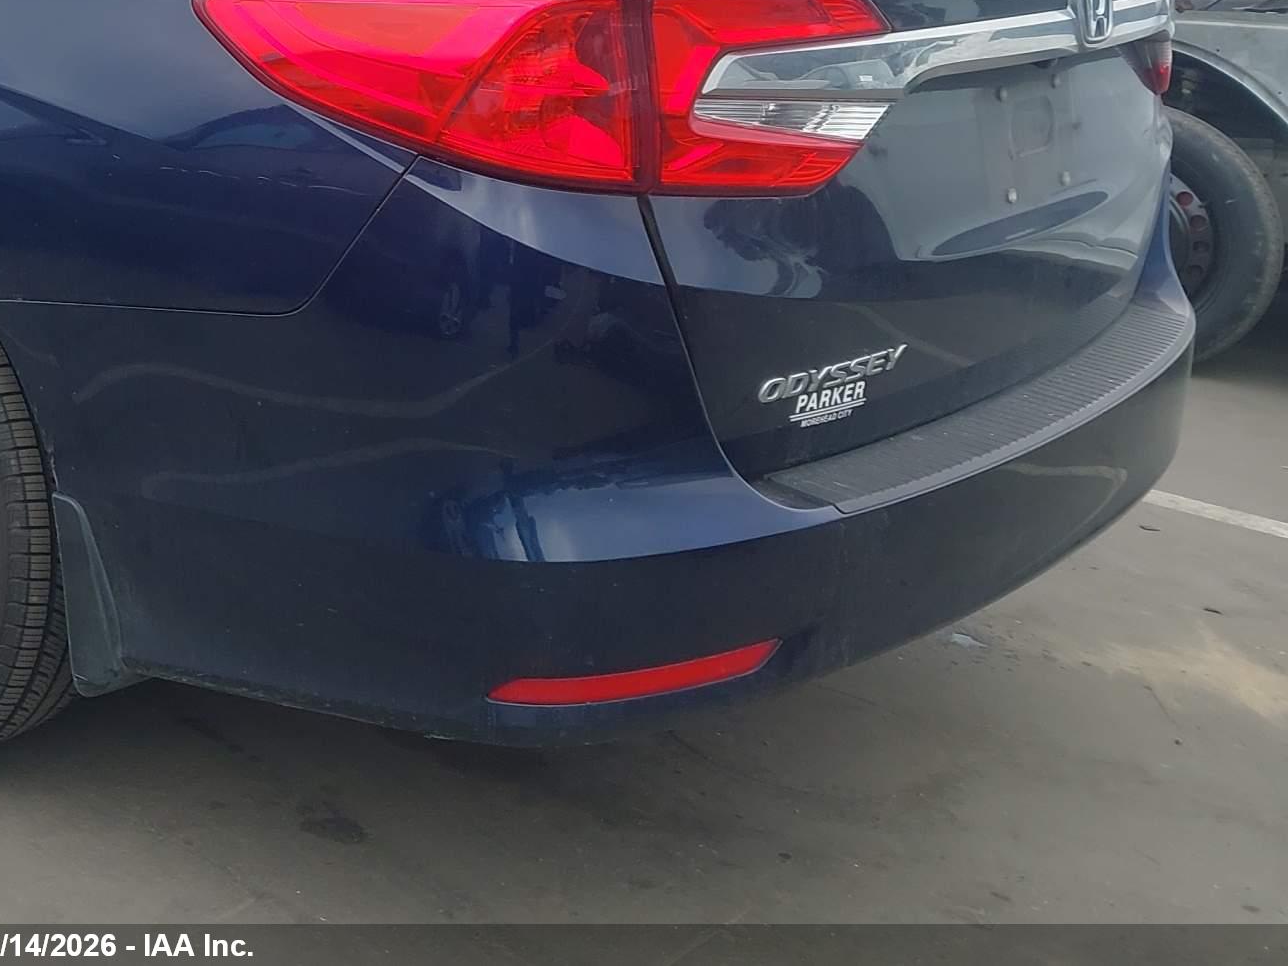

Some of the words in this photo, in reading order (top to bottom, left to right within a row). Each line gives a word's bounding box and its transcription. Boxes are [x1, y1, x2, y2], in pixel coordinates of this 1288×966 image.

[758, 343, 909, 404] ODYSSEY
[795, 380, 867, 414] PARKER
[837, 408, 853, 420] CITY
